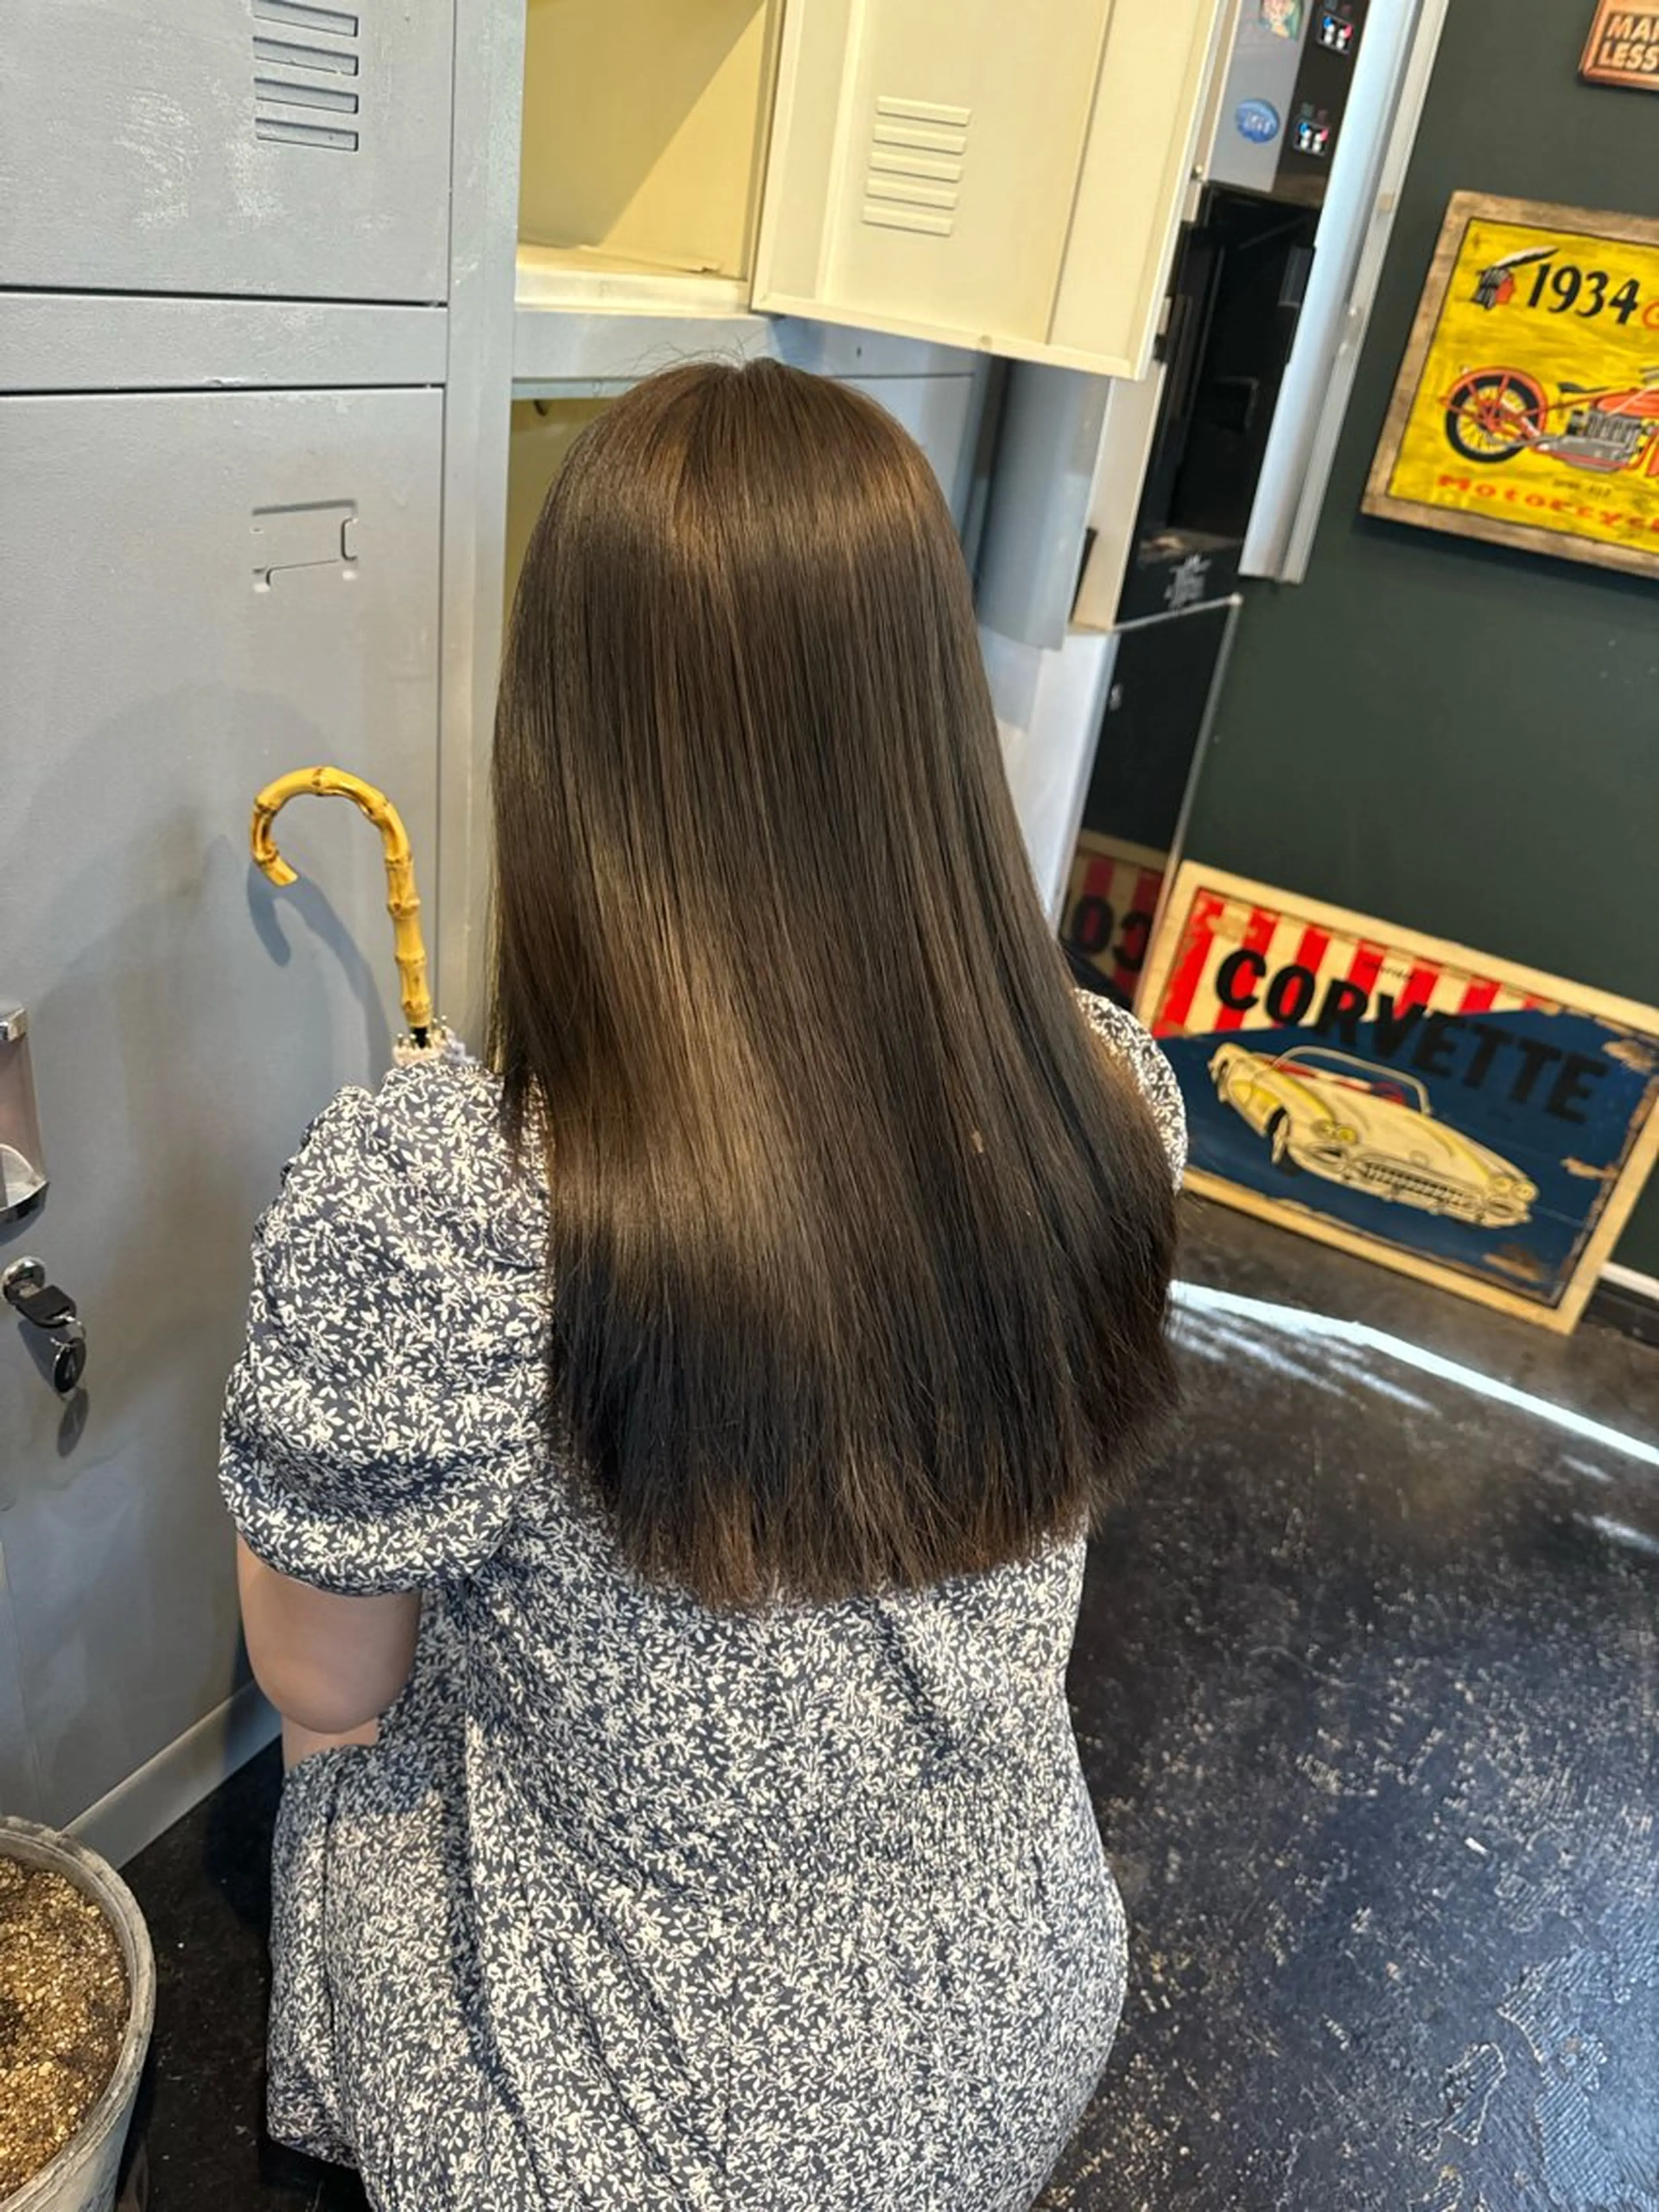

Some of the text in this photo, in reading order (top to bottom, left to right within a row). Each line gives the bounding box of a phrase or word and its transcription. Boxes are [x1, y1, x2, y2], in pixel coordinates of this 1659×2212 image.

[1598, 40, 1659, 71] LESS
[1527, 263, 1640, 325] 1934
[1214, 949, 1609, 1124] CORVETTE
